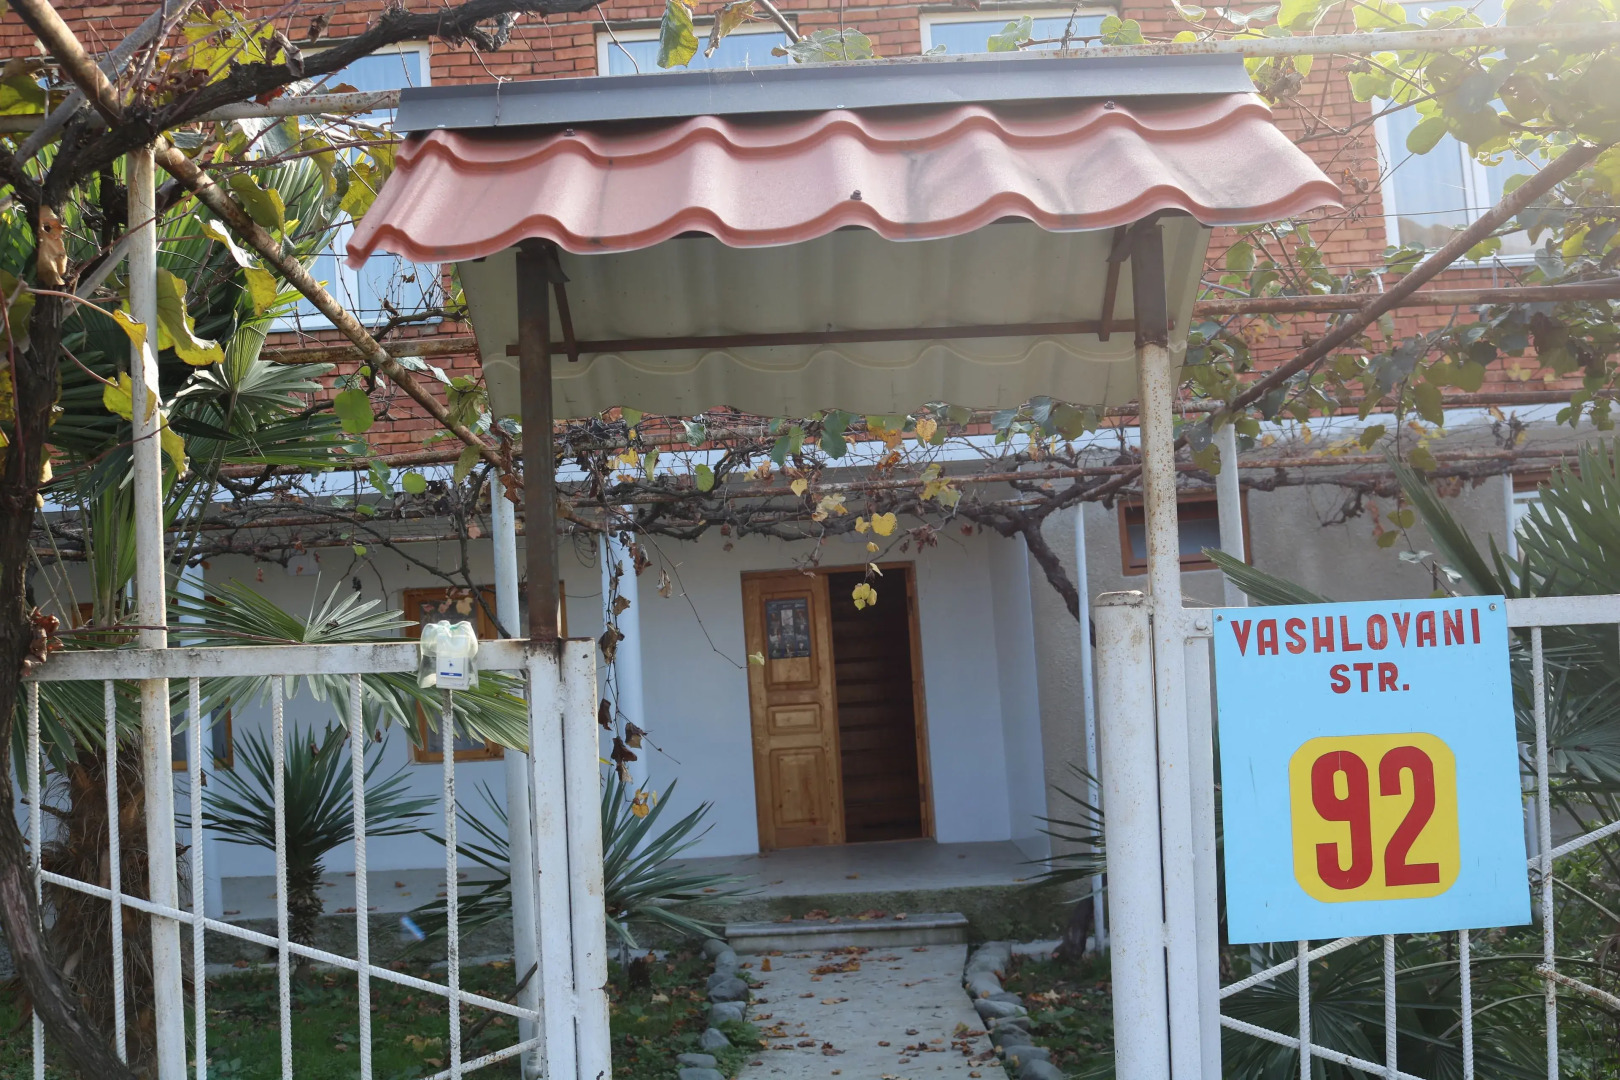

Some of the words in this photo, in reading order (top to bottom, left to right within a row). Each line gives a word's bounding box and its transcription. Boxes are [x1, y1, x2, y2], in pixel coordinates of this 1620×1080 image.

[1230, 608, 1480, 657] VASHLOVANI
[1329, 662, 1410, 694] STR.
[1311, 745, 1441, 890] 92
